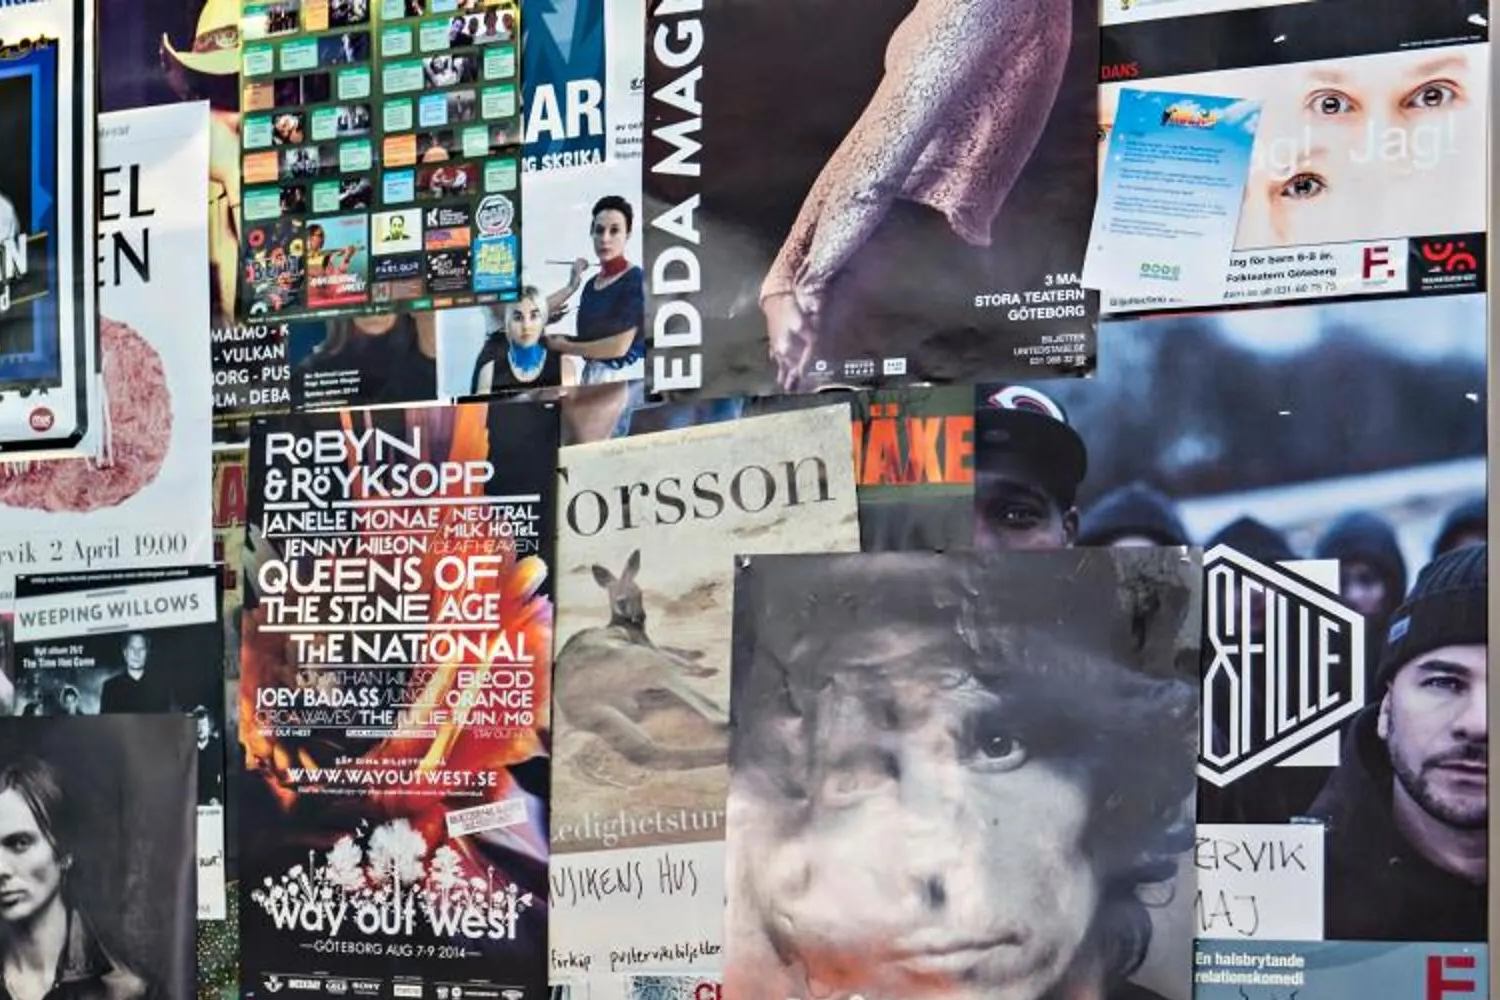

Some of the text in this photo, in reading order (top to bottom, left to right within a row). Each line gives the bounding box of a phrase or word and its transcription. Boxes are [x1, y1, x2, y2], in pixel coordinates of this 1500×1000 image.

[1101, 62, 1140, 79] DANS
[518, 78, 604, 143] AR
[541, 148, 601, 170] SKRIKA
[97, 227, 152, 287] N
[1250, 255, 1265, 267] för
[1268, 253, 1294, 265] barn
[1044, 274, 1053, 286] 3
[652, 194, 703, 392] EDDA
[975, 288, 1085, 308] STORA TEATERN
[1007, 304, 1085, 321] GÖTEBORG
[222, 344, 285, 364] VULKAN
[211, 365, 291, 386] ORG PUS
[211, 387, 291, 408] LM DEBA
[556, 454, 837, 538] orsson
[261, 507, 440, 538] JANELLE MONAE
[451, 505, 540, 522] NEUTRAL
[443, 522, 485, 540] MILK
[50, 540, 63, 563] 2
[72, 535, 120, 568] April
[284, 538, 353, 562] JENNY
[257, 555, 504, 597] QUEENS OF
[19, 593, 200, 628] WEEPING WILLOWS
[258, 596, 320, 624] THE
[436, 593, 501, 622] AGE
[255, 687, 381, 711] JOEY BADASS
[445, 690, 534, 709] ORANGE
[359, 710, 394, 725] THE
[397, 709, 449, 729] JULIE
[452, 710, 497, 726] RUIN
[286, 767, 499, 788] WWW.WAYOUTWEST.SE
[1193, 837, 1307, 873] ERVIK
[549, 852, 699, 909] USIKENS HUS
[269, 895, 520, 941] way out west
[313, 938, 383, 956] GÖTEBORG
[385, 942, 414, 957] AUG
[436, 944, 466, 959] 2014
[1194, 951, 1306, 970] En halsbrytande
[1194, 969, 1305, 986] relationskomedi
